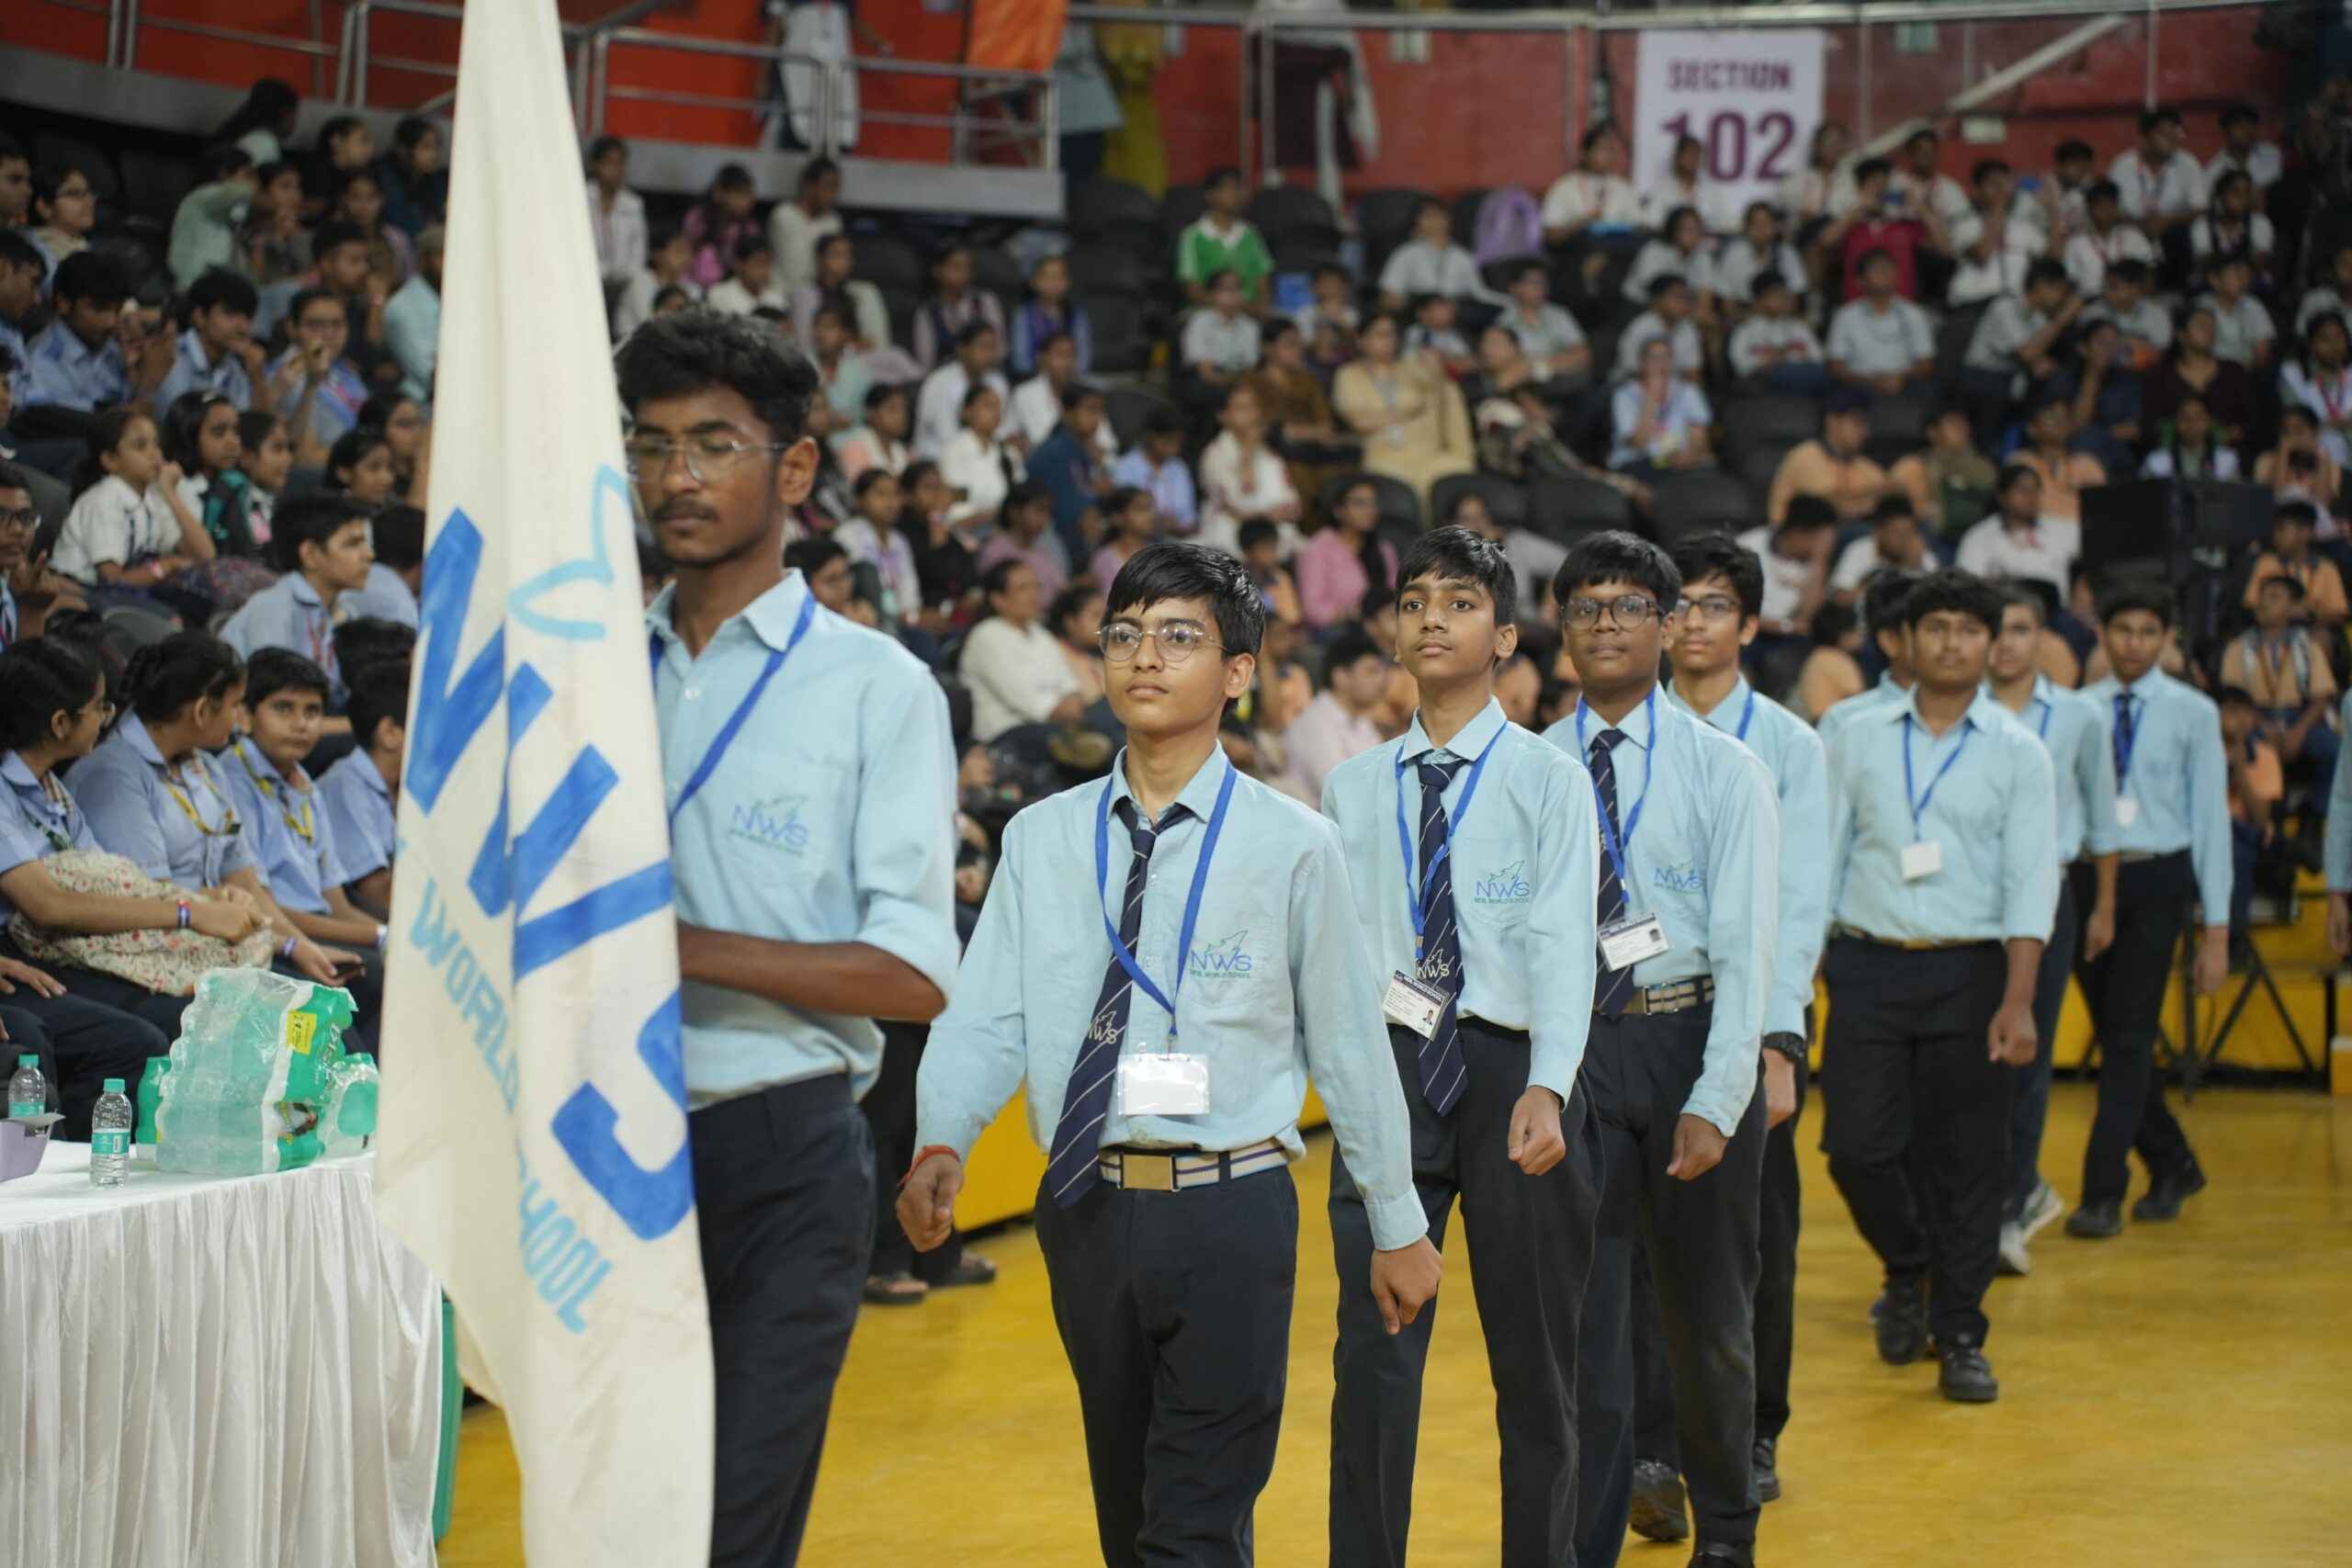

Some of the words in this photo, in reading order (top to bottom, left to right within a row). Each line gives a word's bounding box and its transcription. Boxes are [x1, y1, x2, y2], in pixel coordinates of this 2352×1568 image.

[1668, 58, 1792, 91] SECTION
[730, 805, 808, 848] NWS
[1476, 875, 1530, 897] NWS
[1191, 948, 1252, 972] NWS
[1417, 964, 1450, 979] NWS
[410, 876, 519, 1114] WORLD
[516, 1145, 613, 1336] HOOL
